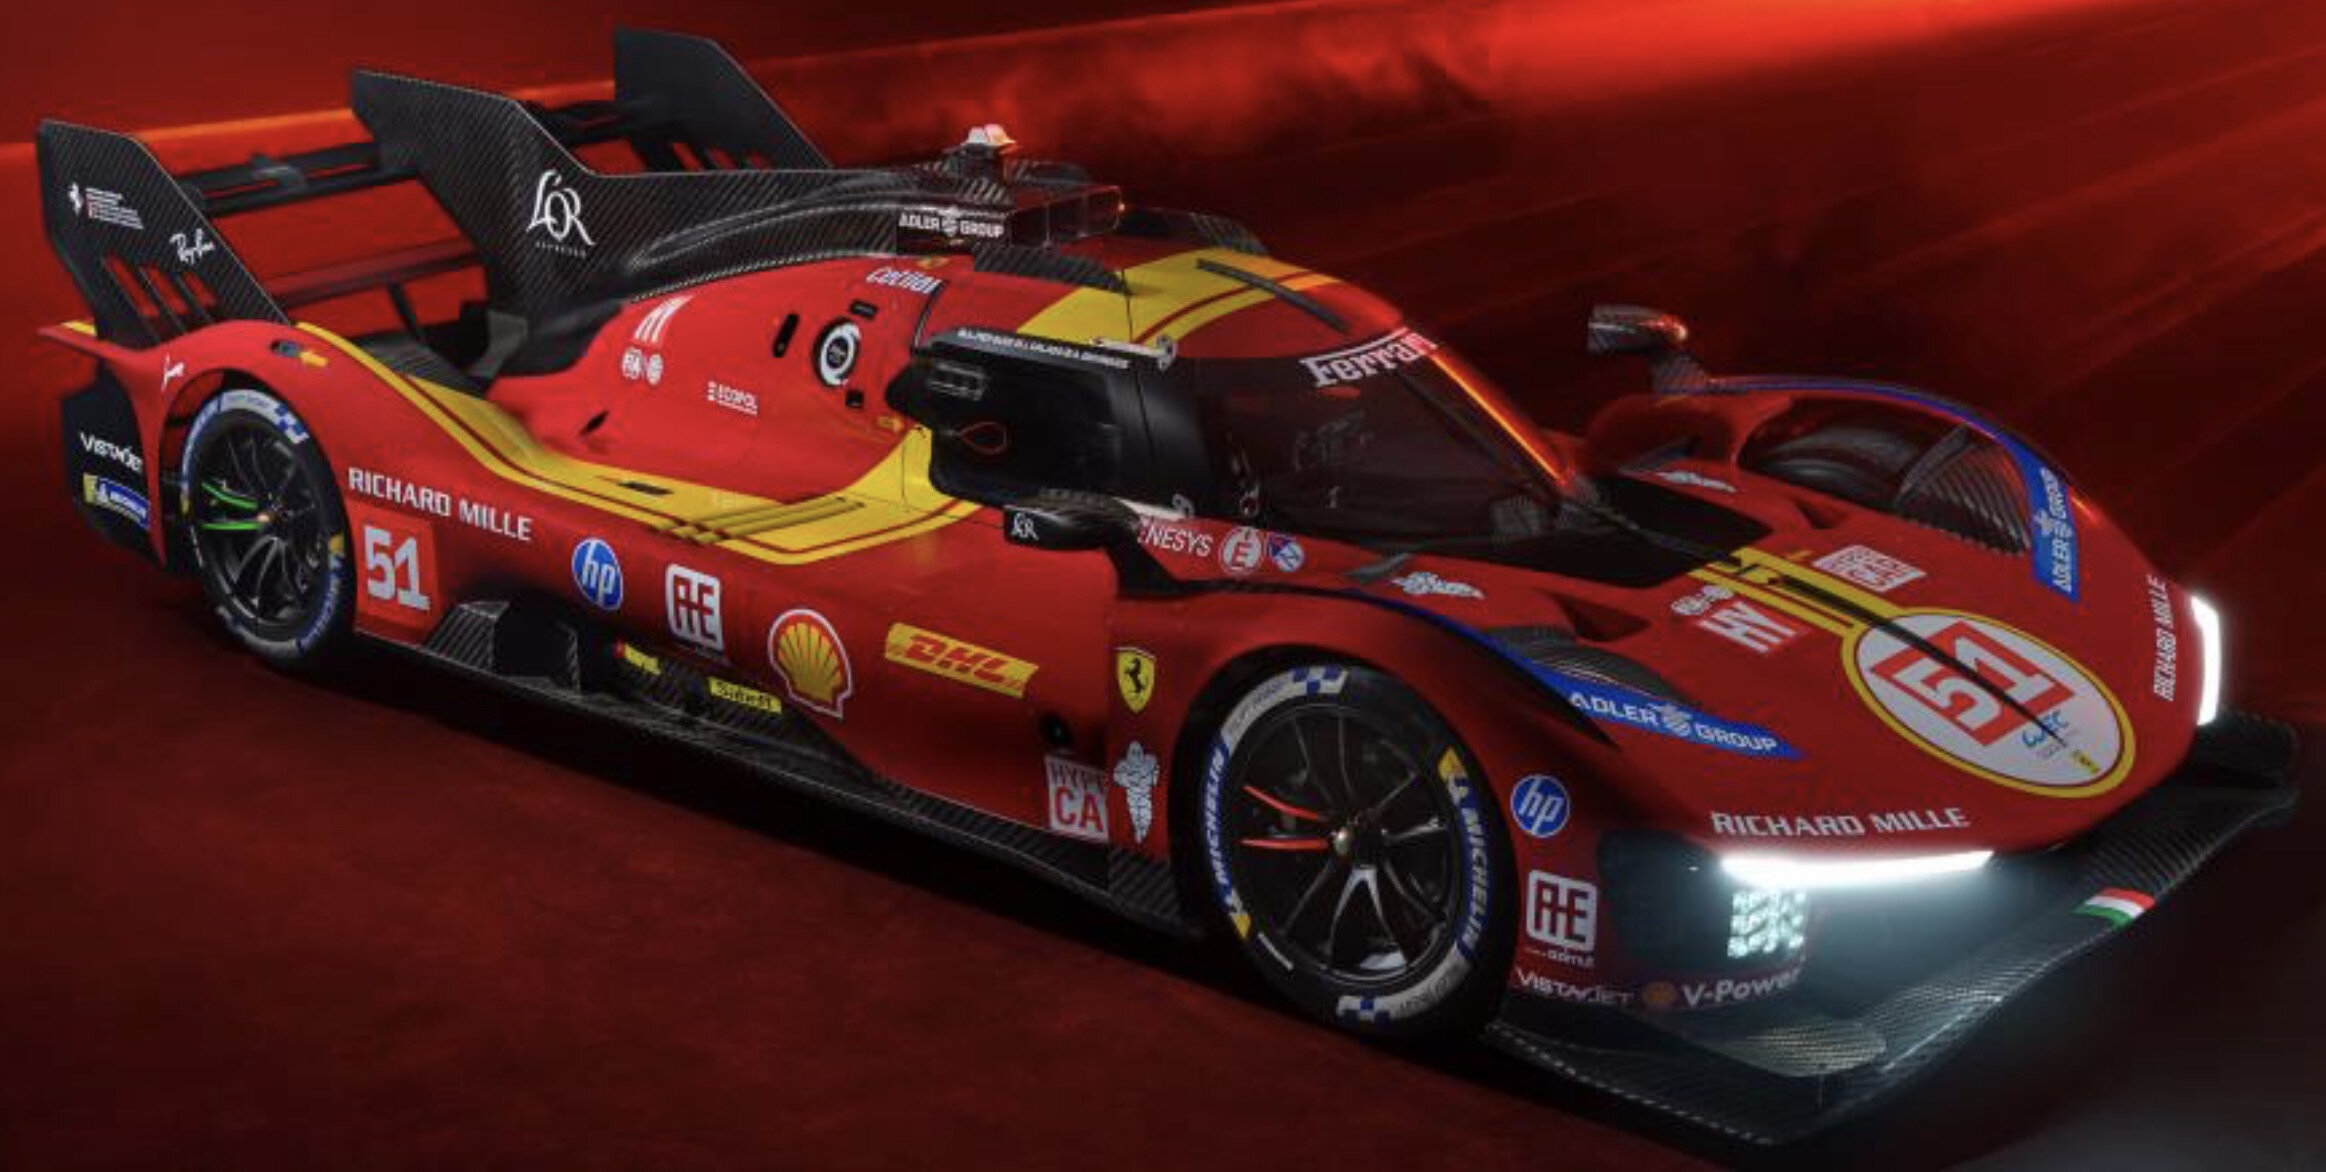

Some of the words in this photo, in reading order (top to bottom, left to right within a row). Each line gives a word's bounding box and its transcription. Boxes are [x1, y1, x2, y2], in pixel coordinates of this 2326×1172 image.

[899, 212, 940, 232] ADLER
[960, 220, 1004, 238] GROUP
[1299, 327, 1438, 388] Ferrari
[349, 467, 451, 516] RICHARD
[458, 498, 533, 541] MILLE
[363, 524, 431, 611] 51
[1139, 524, 1213, 557] NESYS
[581, 541, 616, 611] hp
[2146, 573, 2174, 629] MILLE
[905, 635, 1008, 683] DHL
[1892, 635, 2055, 733] 51
[2153, 626, 2177, 702] RICHARD
[1569, 692, 1659, 727] ADLER
[1694, 722, 1777, 752] GROUP
[1204, 747, 1231, 886] MICHELIN
[1518, 777, 1565, 834] hp
[1711, 811, 1866, 836] RICHARD
[1869, 808, 1971, 833] MILLE
[1461, 806, 1488, 950] MICHELIN
[1682, 967, 1800, 1007] V-Power
